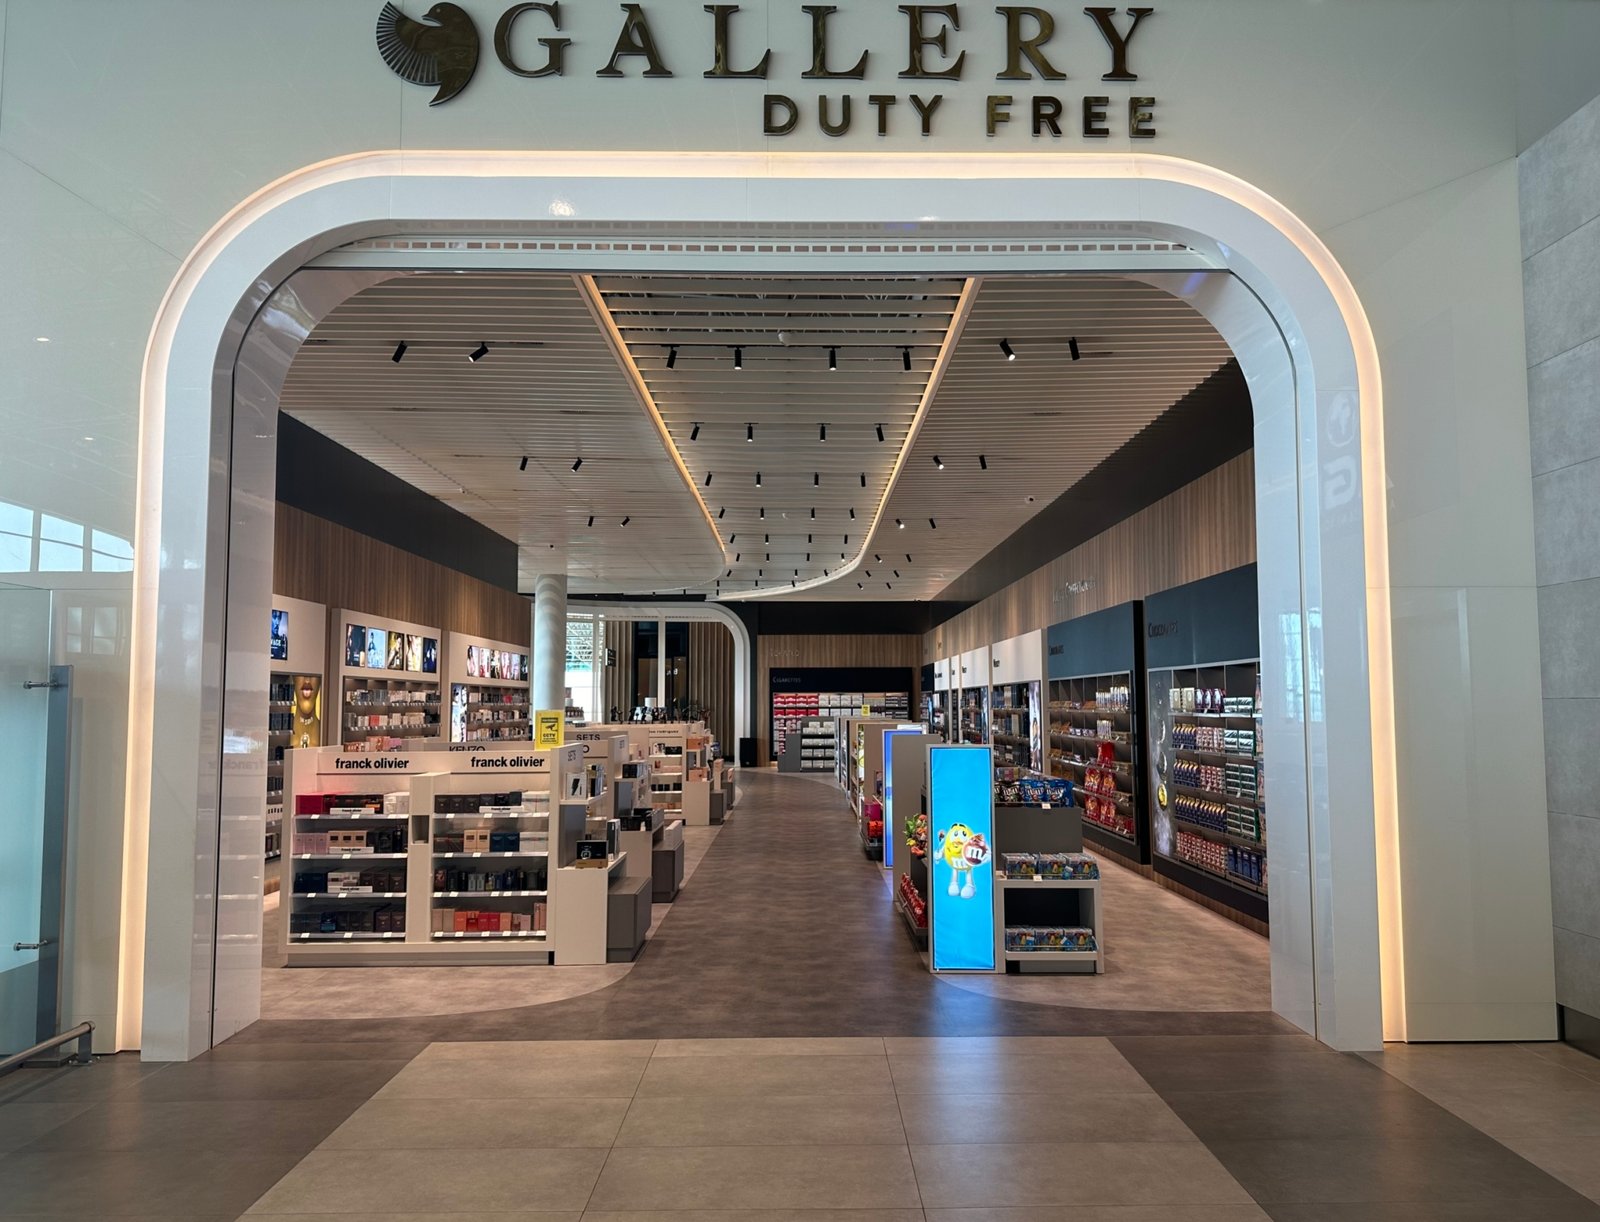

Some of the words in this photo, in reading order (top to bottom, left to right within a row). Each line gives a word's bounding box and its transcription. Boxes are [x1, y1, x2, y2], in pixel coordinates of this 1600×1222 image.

[493, 1, 1154, 80] GALLERY
[763, 94, 942, 137] DUTY
[985, 95, 1157, 139] FREE
[335, 757, 372, 769] franck
[373, 758, 409, 769] olivier
[470, 756, 508, 768] franck
[509, 756, 545, 768] olivier
